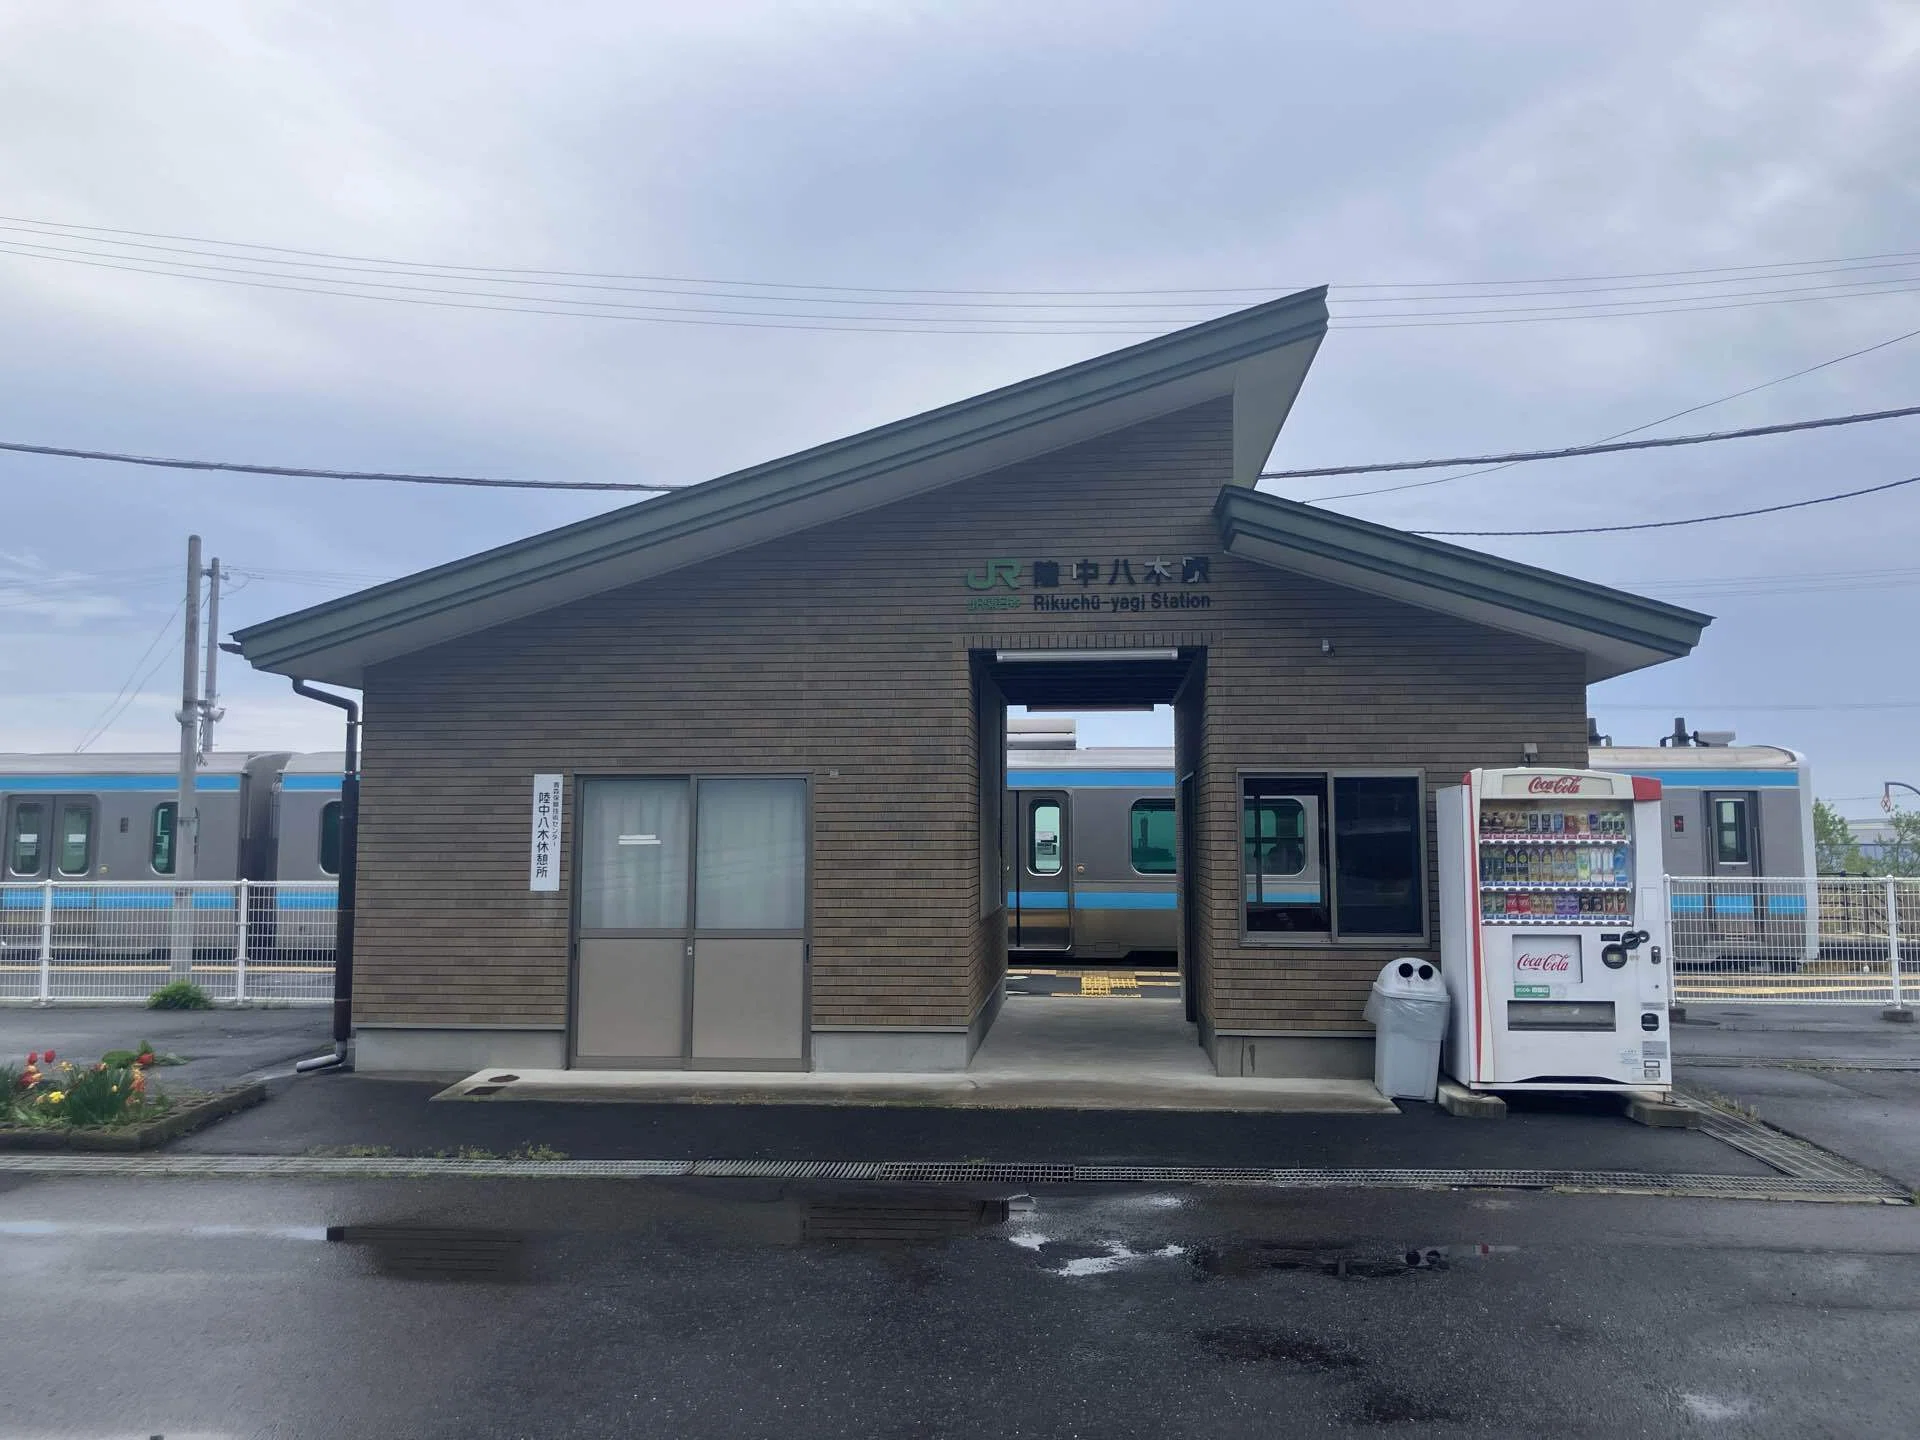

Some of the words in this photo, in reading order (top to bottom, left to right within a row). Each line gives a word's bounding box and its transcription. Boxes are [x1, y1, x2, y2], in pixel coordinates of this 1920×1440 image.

[967, 558, 1024, 590] JR
[1151, 592, 1210, 610] Station
[1528, 775, 1582, 794] Coca-Cola
[536, 792, 550, 878] 陸中八木休憩所
[1517, 953, 1569, 971] Coca-Cola
